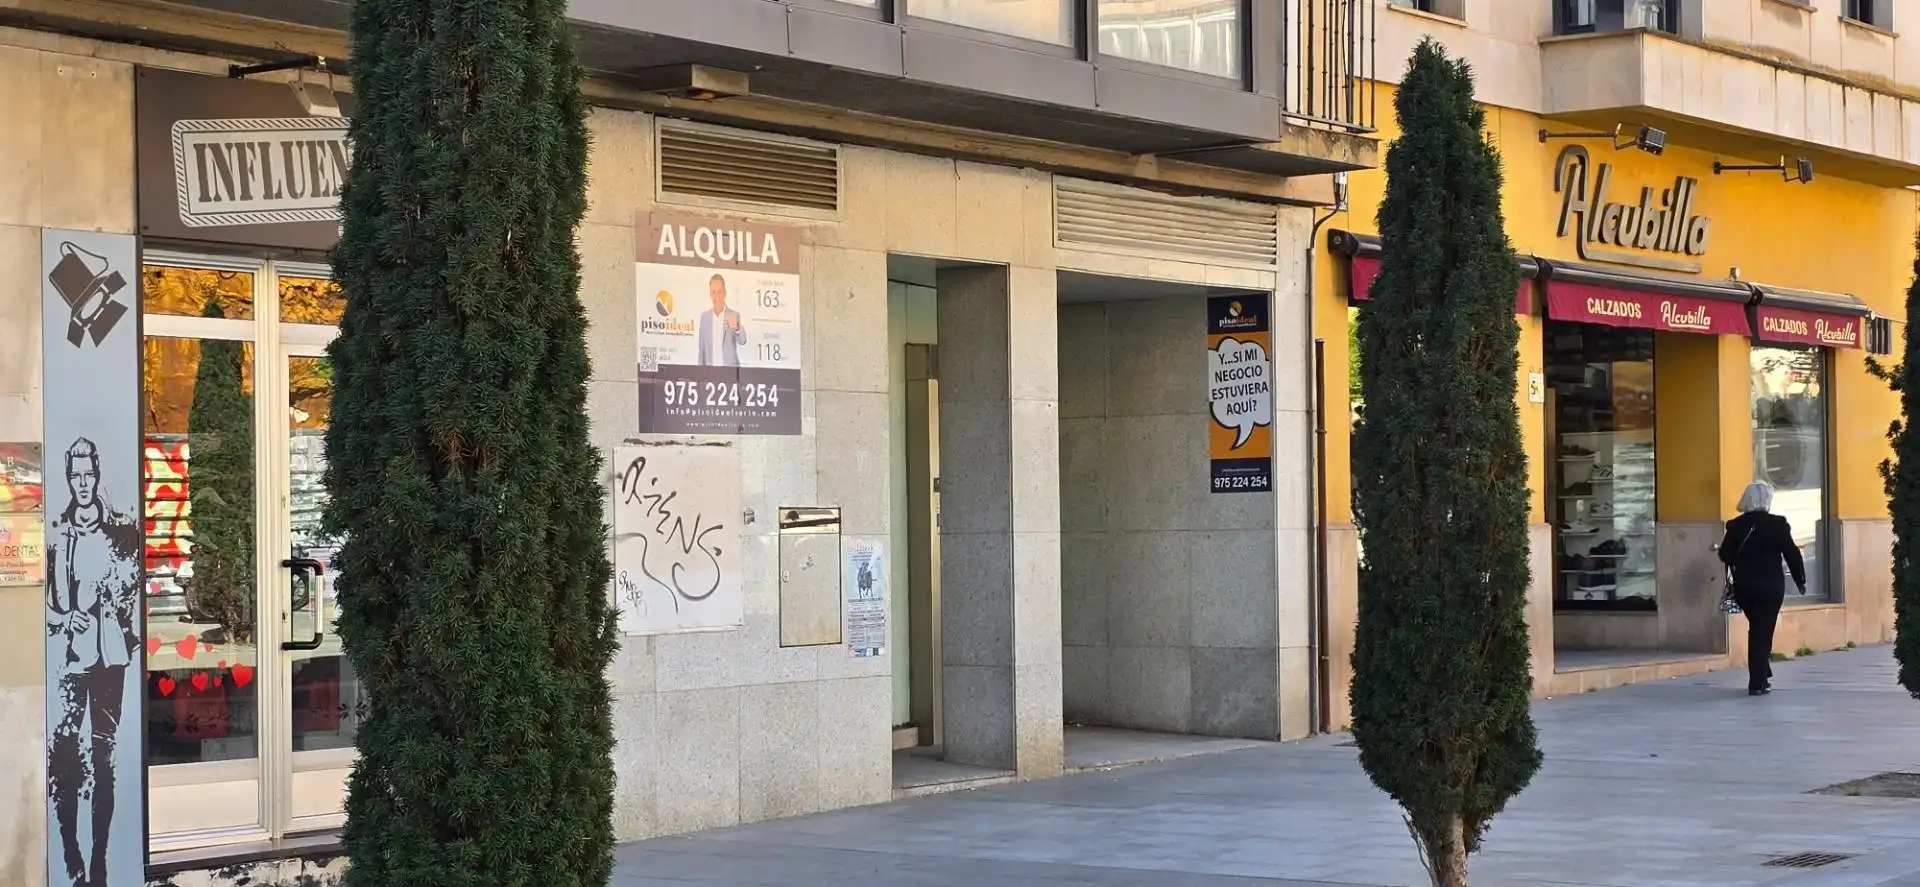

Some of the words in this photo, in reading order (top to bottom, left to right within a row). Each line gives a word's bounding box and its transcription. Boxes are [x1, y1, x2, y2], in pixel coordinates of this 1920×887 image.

[1554, 144, 1712, 275] Alcubilla
[657, 224, 780, 265] ALQUILA
[756, 289, 779, 308] 163
[1587, 297, 1642, 320] CALZADOS
[1660, 301, 1711, 330] Alcubilla
[1763, 316, 1808, 336] CALZADOS
[1814, 318, 1857, 345] Alcubilla
[757, 343, 781, 361] 118
[1244, 348, 1258, 361] MI
[1214, 364, 1263, 383] NEGOCIO
[664, 380, 698, 406] 975
[705, 381, 740, 407] 224
[745, 382, 779, 408] 254
[1211, 381, 1269, 401] ESTUVIERA
[1226, 397, 1257, 416] AQUÍ?
[1214, 477, 1231, 488] 975
[1232, 476, 1249, 488] 224
[1250, 475, 1268, 487] 254
